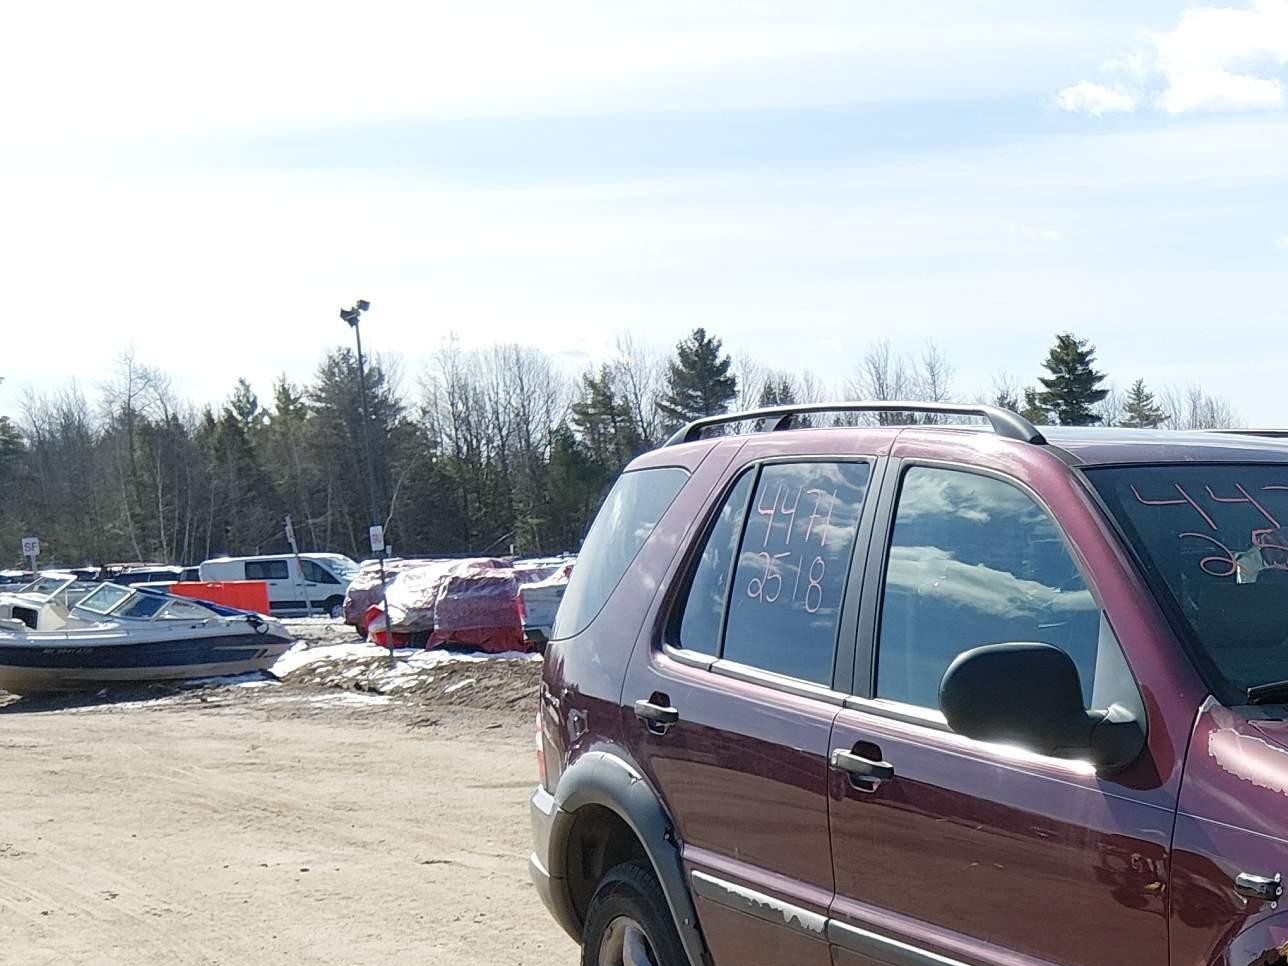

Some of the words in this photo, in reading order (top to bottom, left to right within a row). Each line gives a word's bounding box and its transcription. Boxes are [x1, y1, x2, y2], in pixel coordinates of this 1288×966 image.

[758, 481, 838, 548] 4471
[24, 542, 38, 552] SF
[747, 551, 826, 613] 2518
